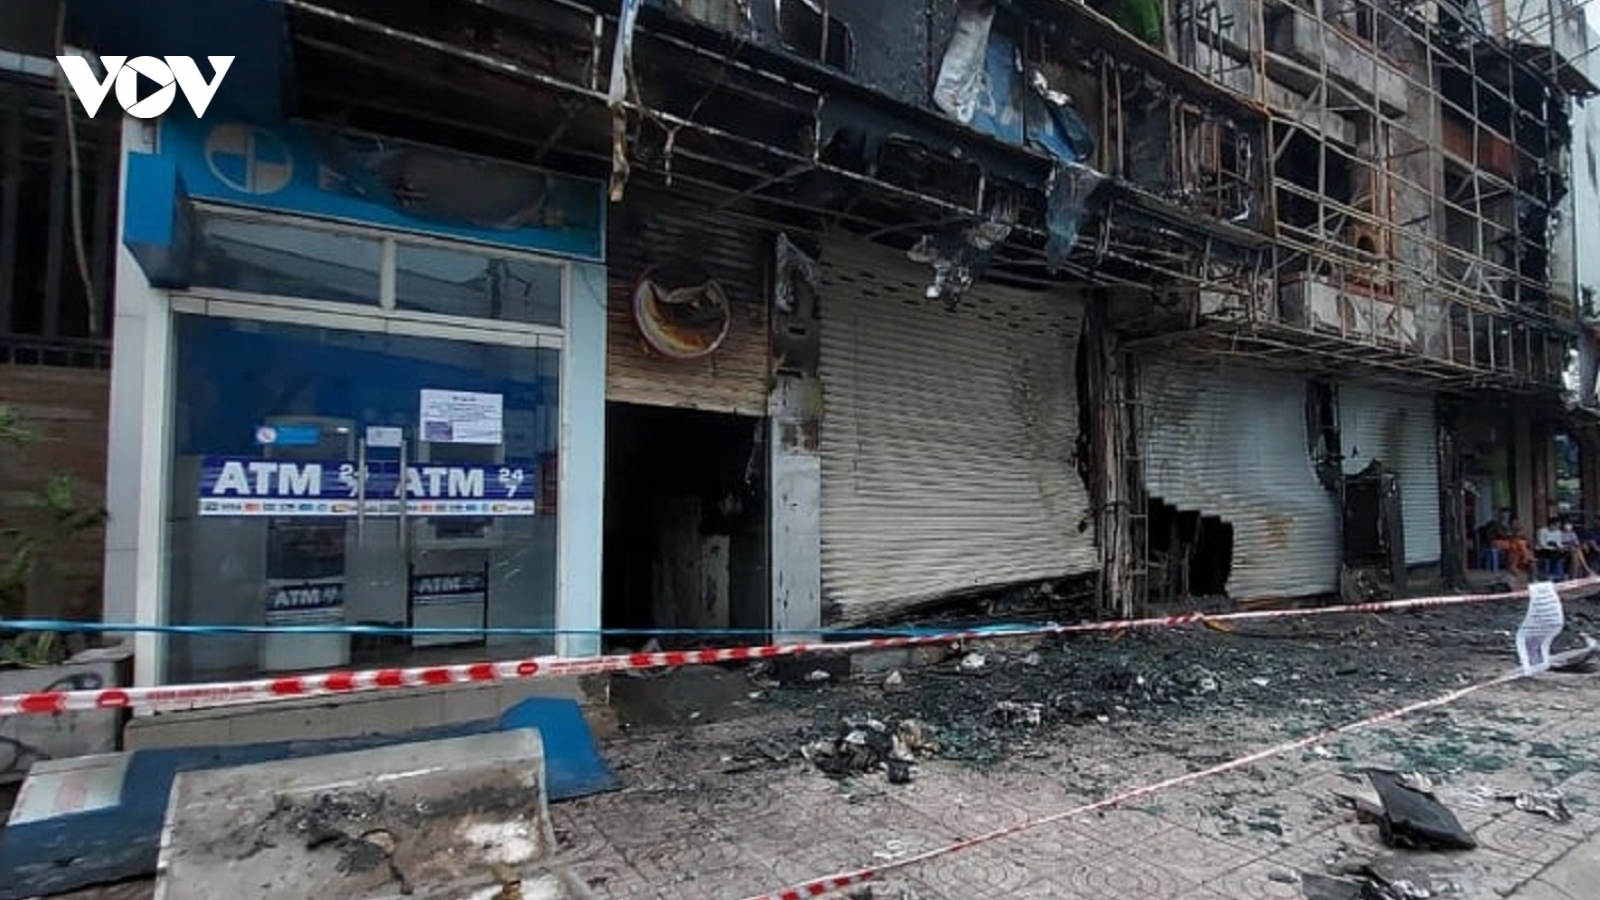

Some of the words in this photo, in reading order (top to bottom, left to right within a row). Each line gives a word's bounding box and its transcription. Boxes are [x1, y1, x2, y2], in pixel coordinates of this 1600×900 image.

[212, 461, 322, 496] ATM
[394, 467, 485, 497] ATM
[418, 576, 461, 594] ATM
[274, 588, 320, 608] ATM
